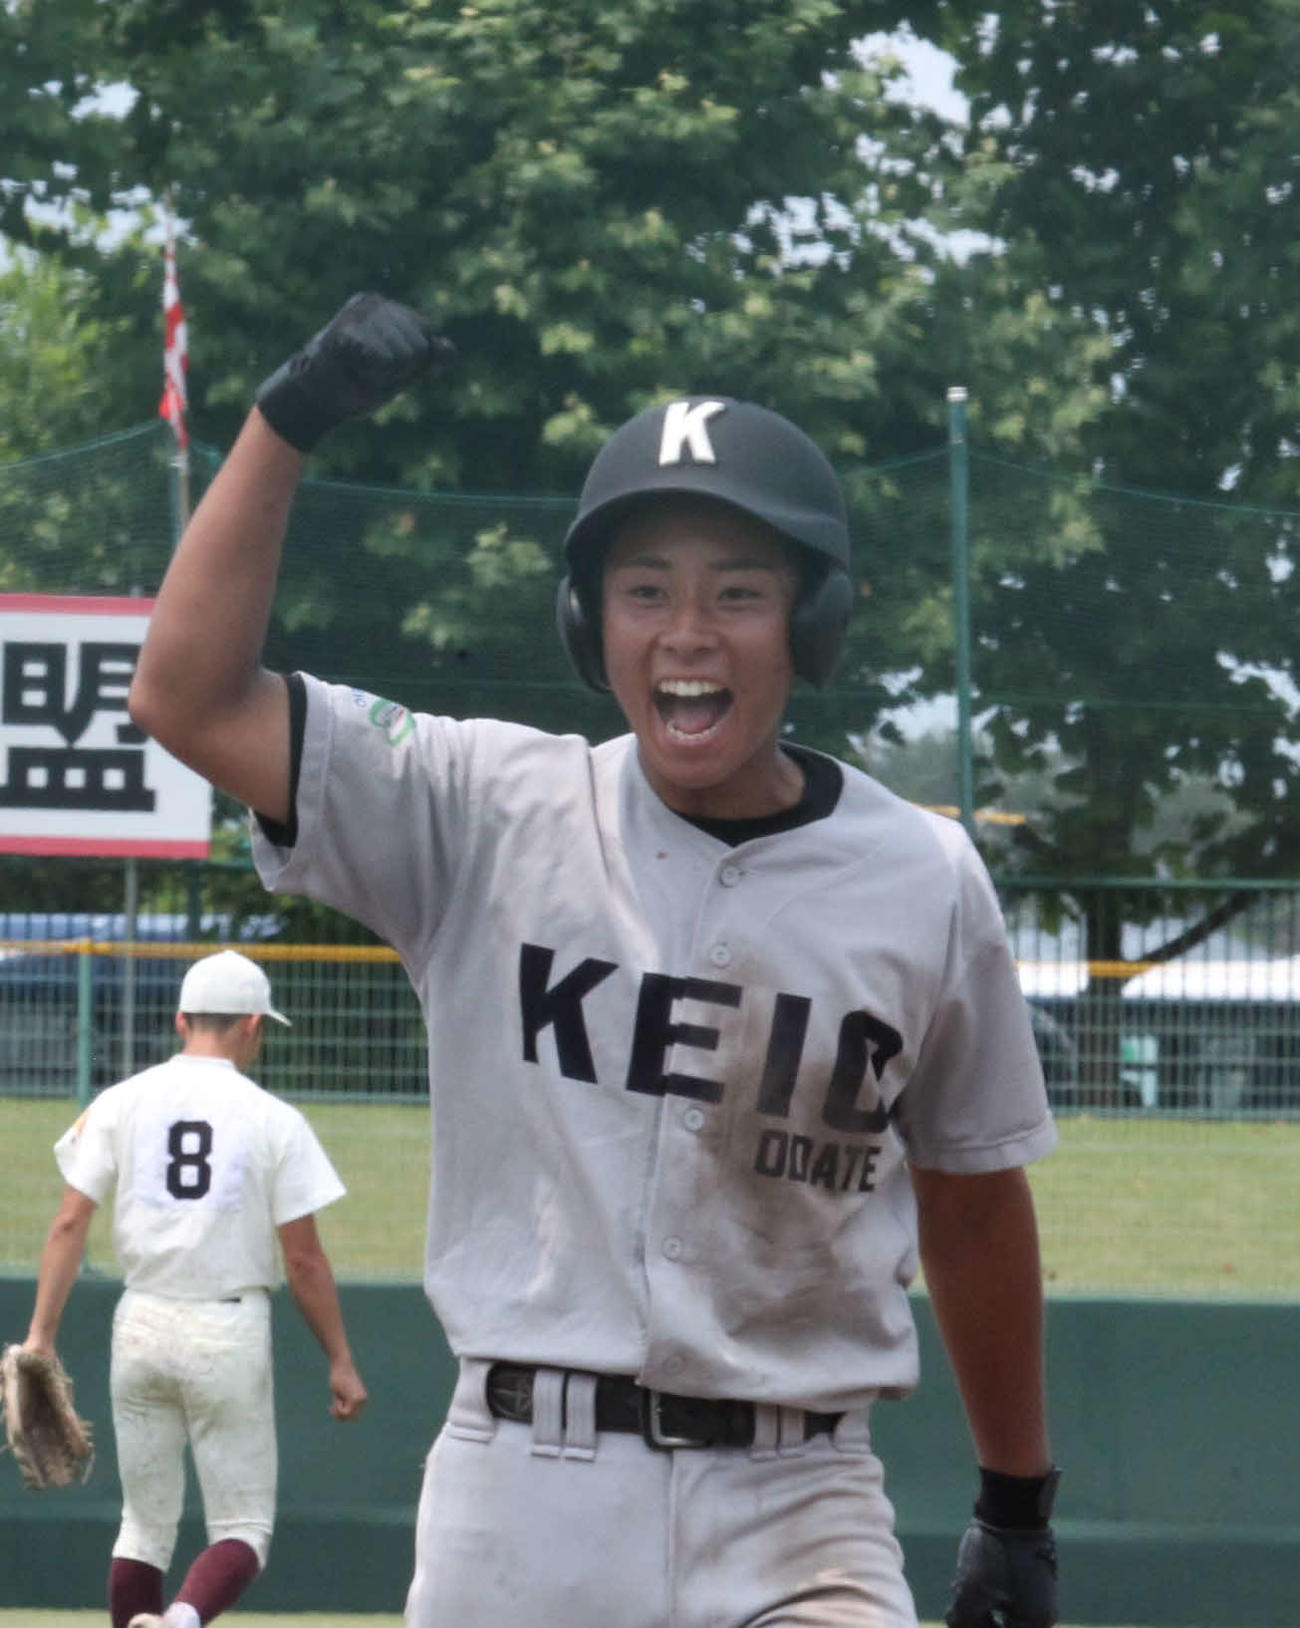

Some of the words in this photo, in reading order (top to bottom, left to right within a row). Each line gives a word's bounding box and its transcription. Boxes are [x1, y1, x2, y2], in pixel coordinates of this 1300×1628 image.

[659, 401, 725, 467] K
[0, 642, 156, 812] 盟
[166, 1120, 213, 1200] 8
[754, 1129, 882, 1193] ODATE
